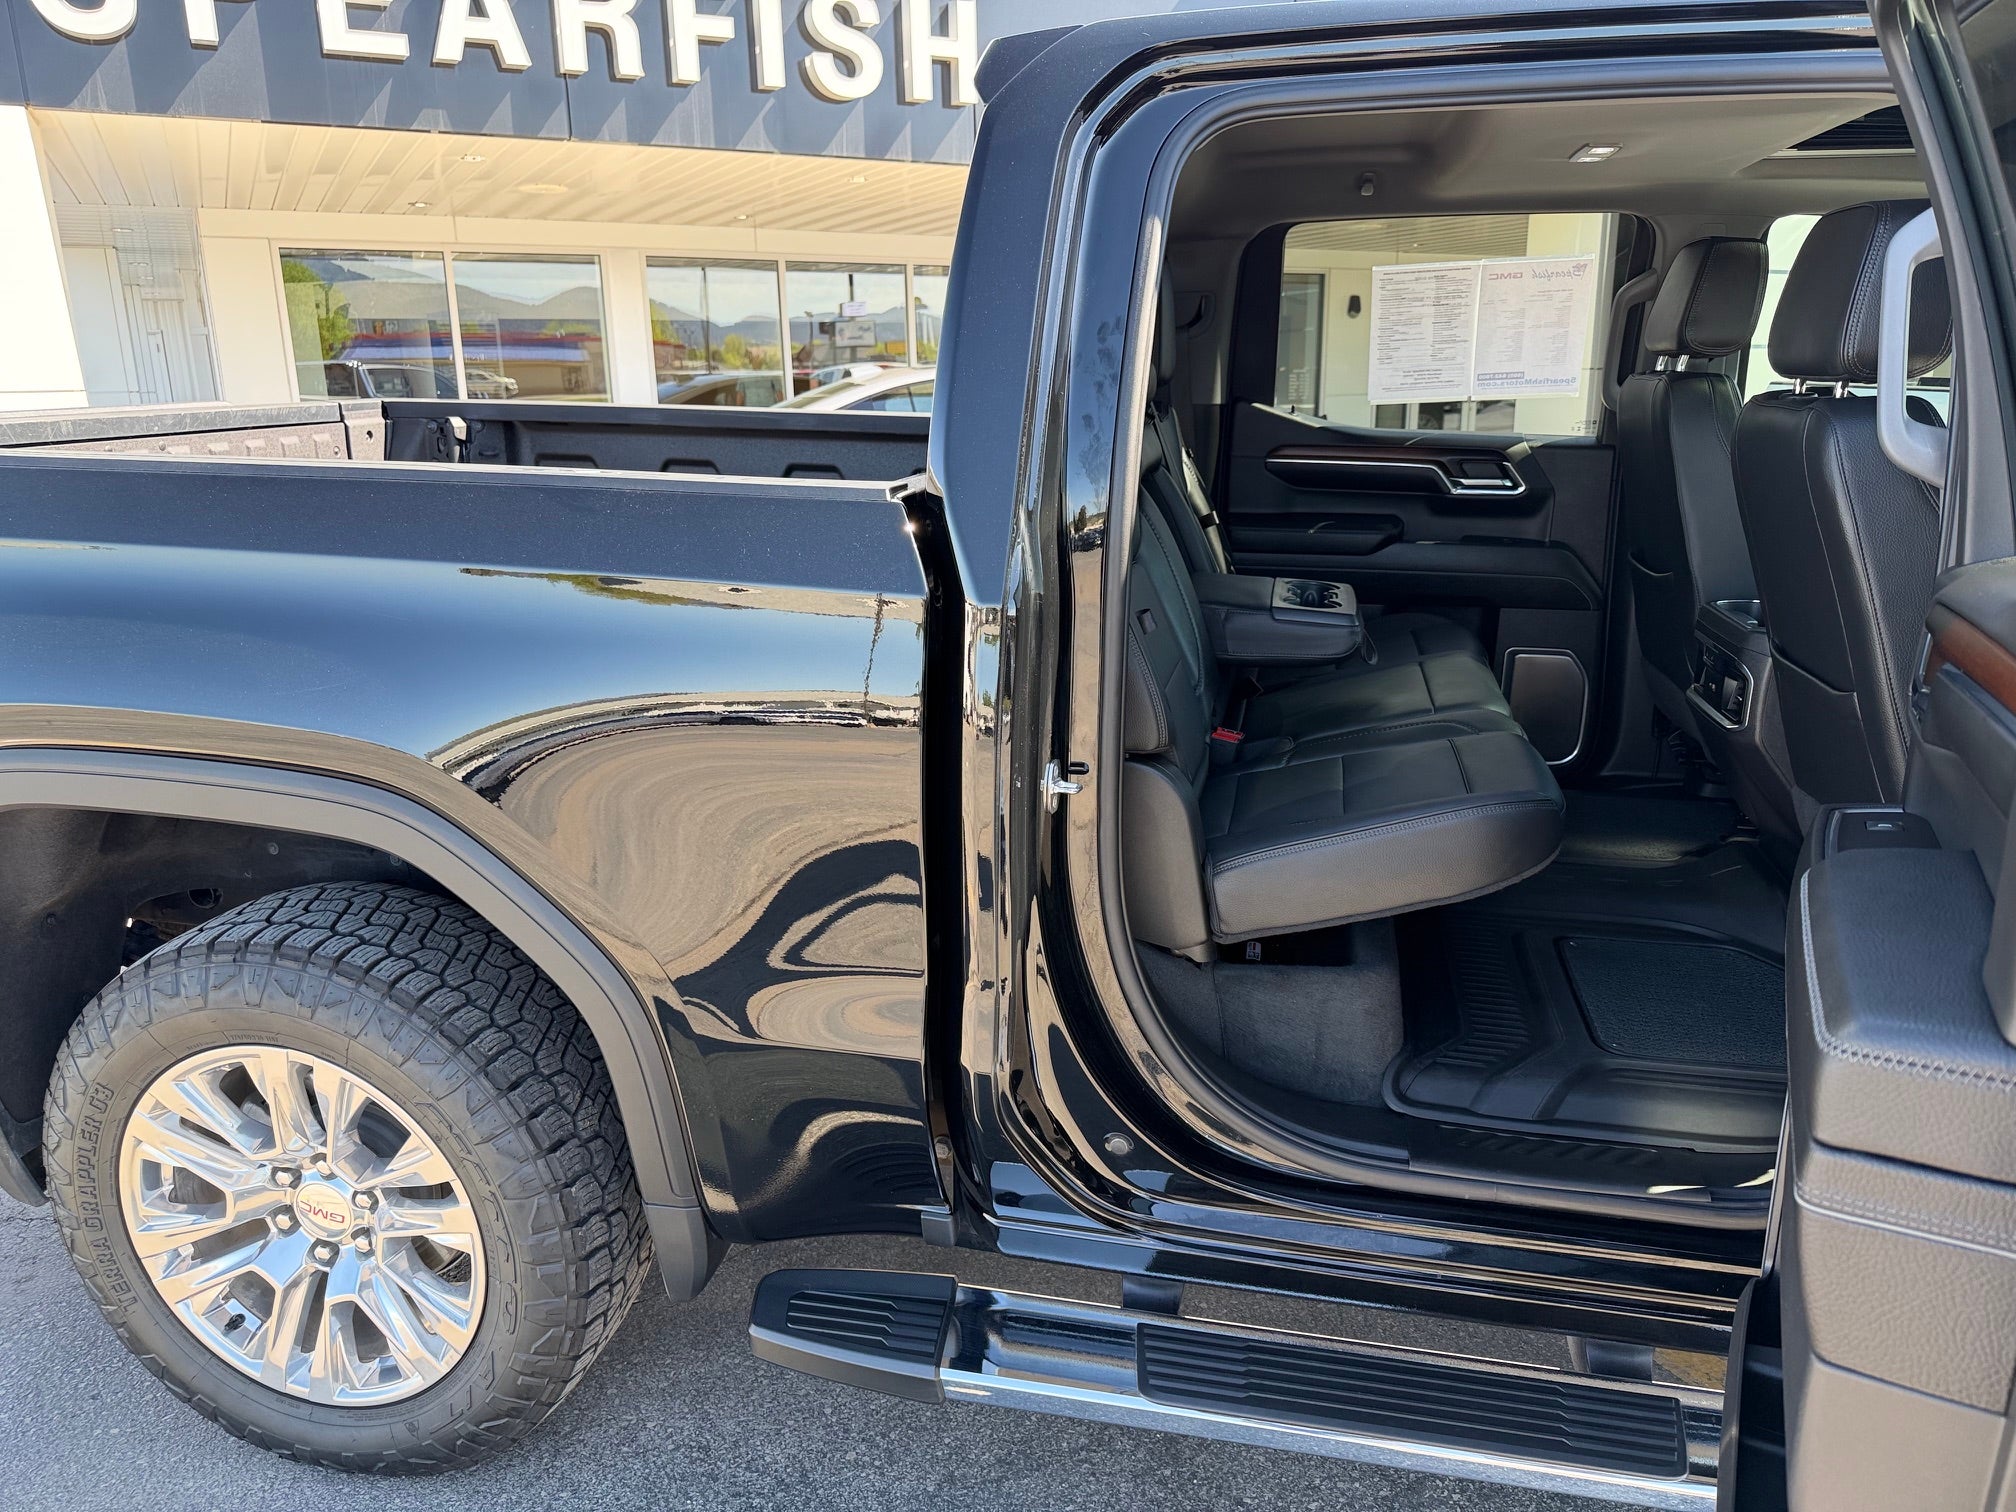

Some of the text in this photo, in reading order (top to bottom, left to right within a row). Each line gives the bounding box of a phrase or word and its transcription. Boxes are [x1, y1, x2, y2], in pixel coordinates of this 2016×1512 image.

[30, 0, 979, 107] EARFISH
[77, 1113, 104, 1232] GRAPPLER
[299, 1200, 346, 1224] GMC
[91, 1236, 139, 1315] TERRA
